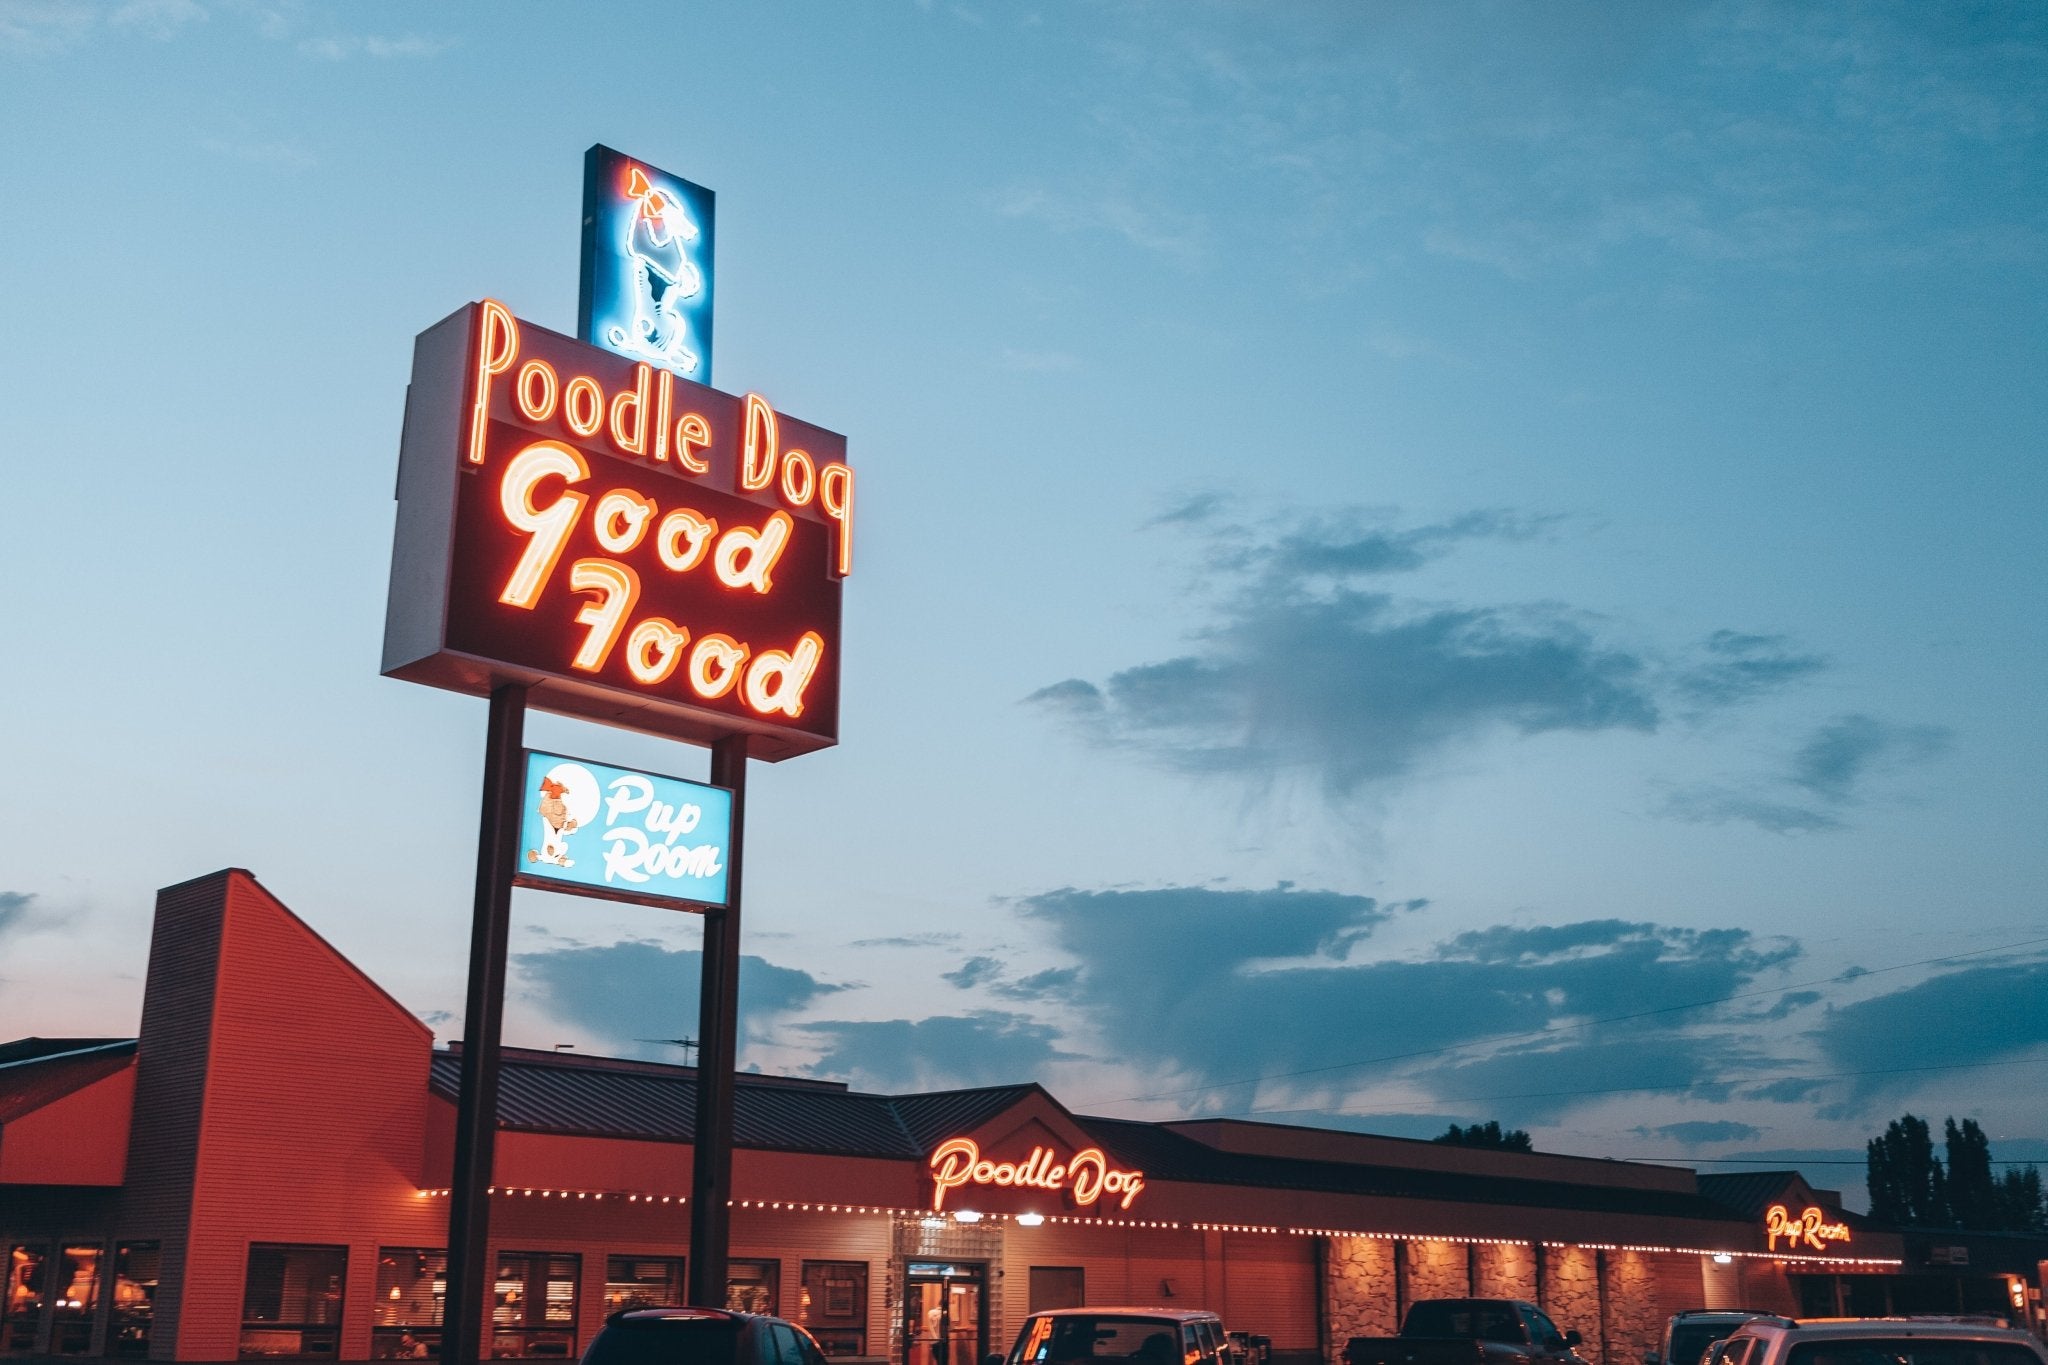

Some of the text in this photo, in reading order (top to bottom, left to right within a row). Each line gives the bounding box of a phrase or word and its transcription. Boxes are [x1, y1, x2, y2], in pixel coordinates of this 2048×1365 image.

[469, 299, 854, 577] Poodle Dog
[498, 440, 794, 610] Good
[570, 558, 826, 719] Food
[604, 775, 701, 845] Pup
[602, 826, 722, 883] Room
[931, 1137, 1144, 1211] Poodle Dog
[1766, 1205, 1851, 1251] Pup Room
